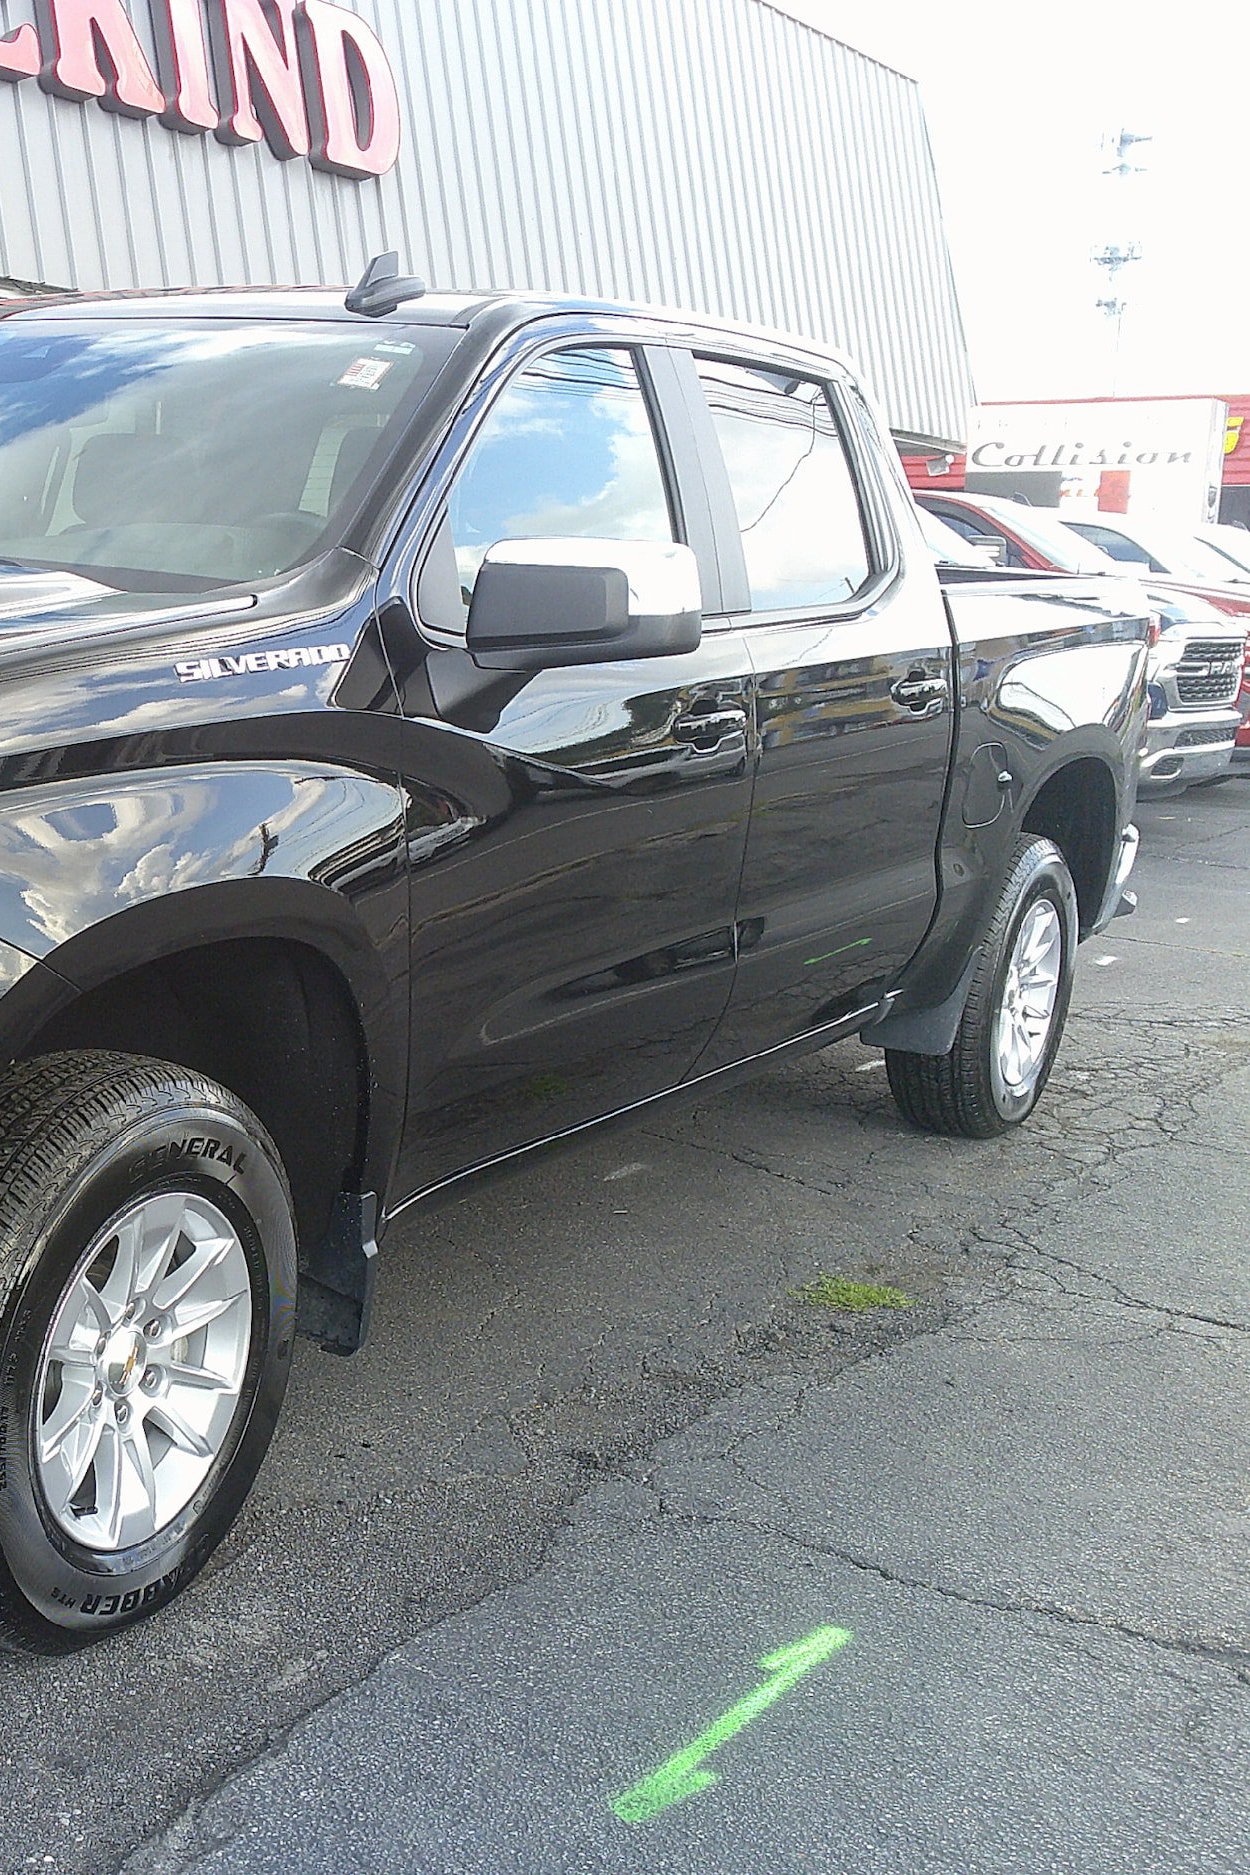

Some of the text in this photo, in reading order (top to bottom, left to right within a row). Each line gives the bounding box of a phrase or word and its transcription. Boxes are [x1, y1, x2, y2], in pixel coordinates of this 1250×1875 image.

[971, 441, 1192, 467] Collision
[174, 644, 350, 683] SILVERADO
[128, 1136, 247, 1184] GENERAL
